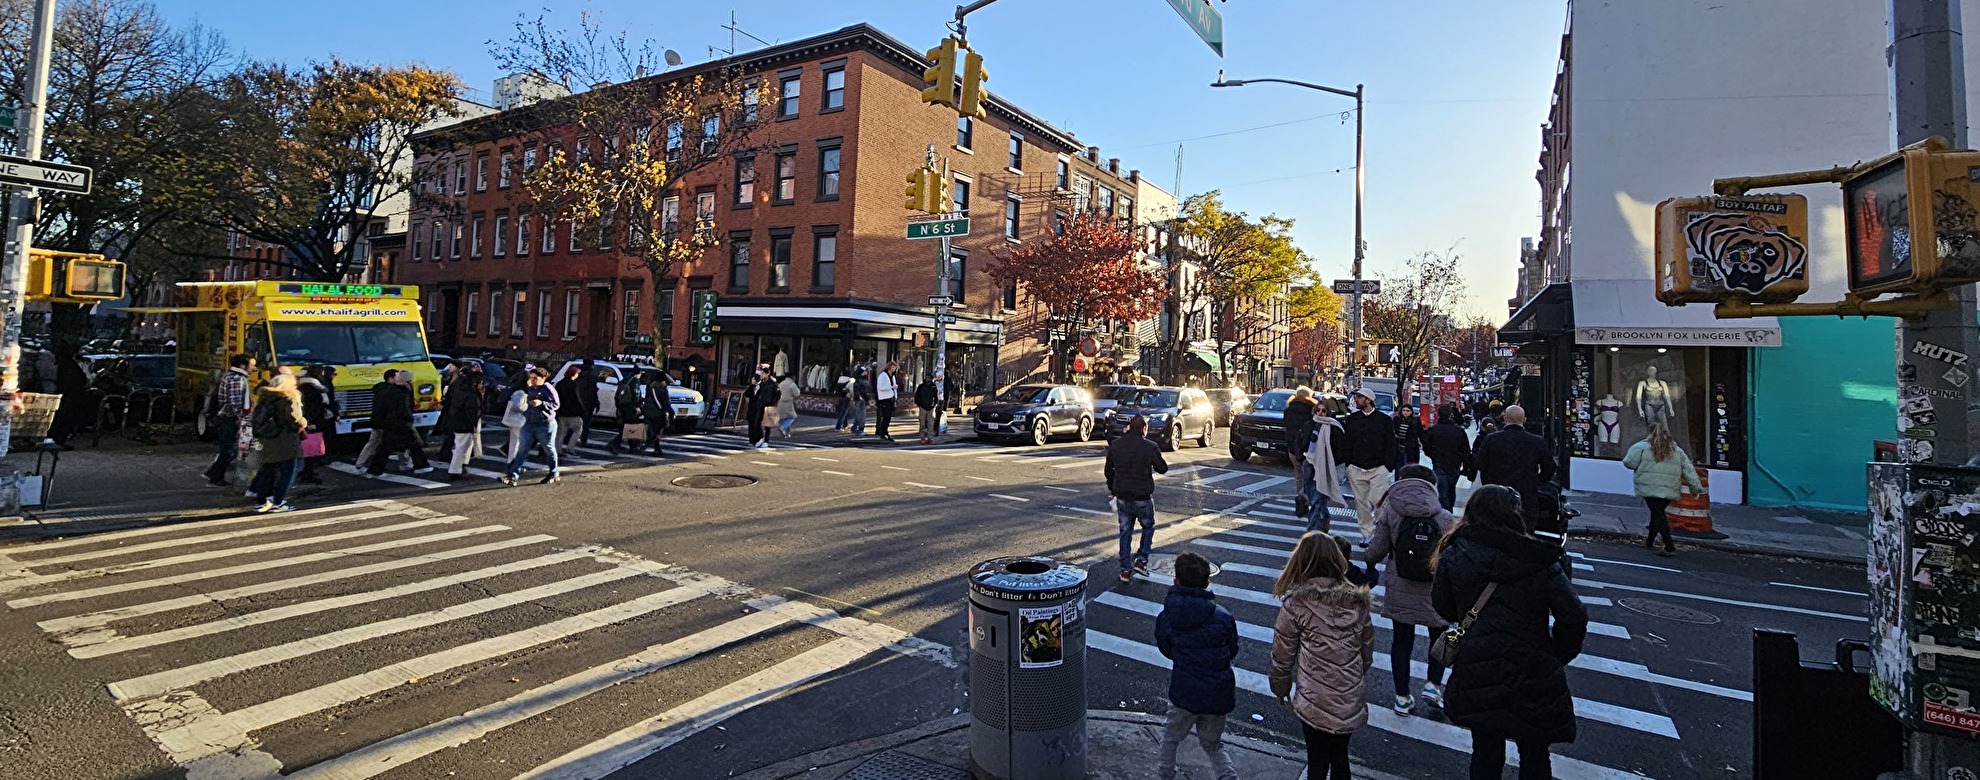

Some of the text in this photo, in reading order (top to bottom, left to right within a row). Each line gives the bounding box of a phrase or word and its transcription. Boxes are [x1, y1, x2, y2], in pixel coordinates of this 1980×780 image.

[42, 169, 80, 183] WAY
[920, 223, 955, 235] N 6 St
[301, 284, 382, 296] HALAL FOOD
[281, 308, 407, 317] www.khalifagrill.com
[1611, 331, 1663, 339] BROOKLYN
[1692, 332, 1741, 340] LINGERIE
[1912, 340, 1968, 366] MUTZ
[1911, 386, 1962, 399] CARDINAL
[980, 587, 999, 598] Don't
[1001, 592, 1024, 601] litter
[1040, 590, 1063, 600] Don't
[1927, 710, 1956, 724] (646)
